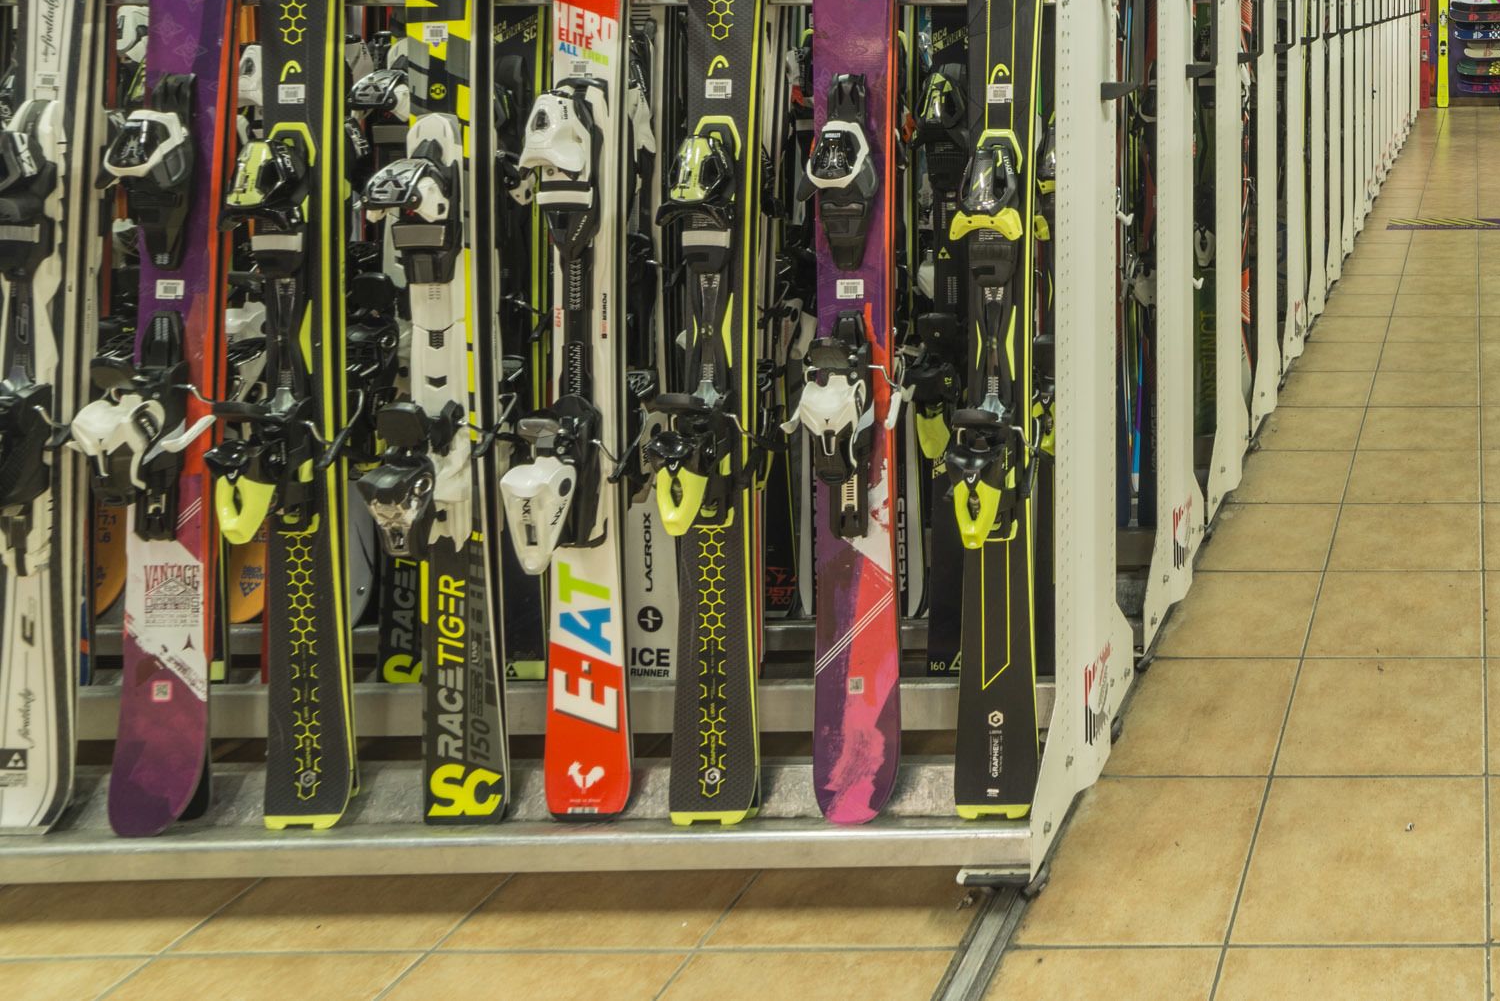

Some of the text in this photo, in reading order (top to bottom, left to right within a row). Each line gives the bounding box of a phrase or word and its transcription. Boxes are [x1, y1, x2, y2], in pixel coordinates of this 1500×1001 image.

[522, 24, 538, 43] SC
[552, 0, 619, 41] HERO
[558, 26, 593, 50] ELITE
[558, 41, 579, 57] ALL
[642, 511, 653, 593] LACROIX
[143, 563, 201, 593] VANTAGE
[630, 646, 671, 668] ICE
[630, 667, 670, 678] RUNNER
[469, 717, 491, 763] 150
[991, 735, 1000, 779] GRAPHENE
[426, 762, 503, 818] SC
